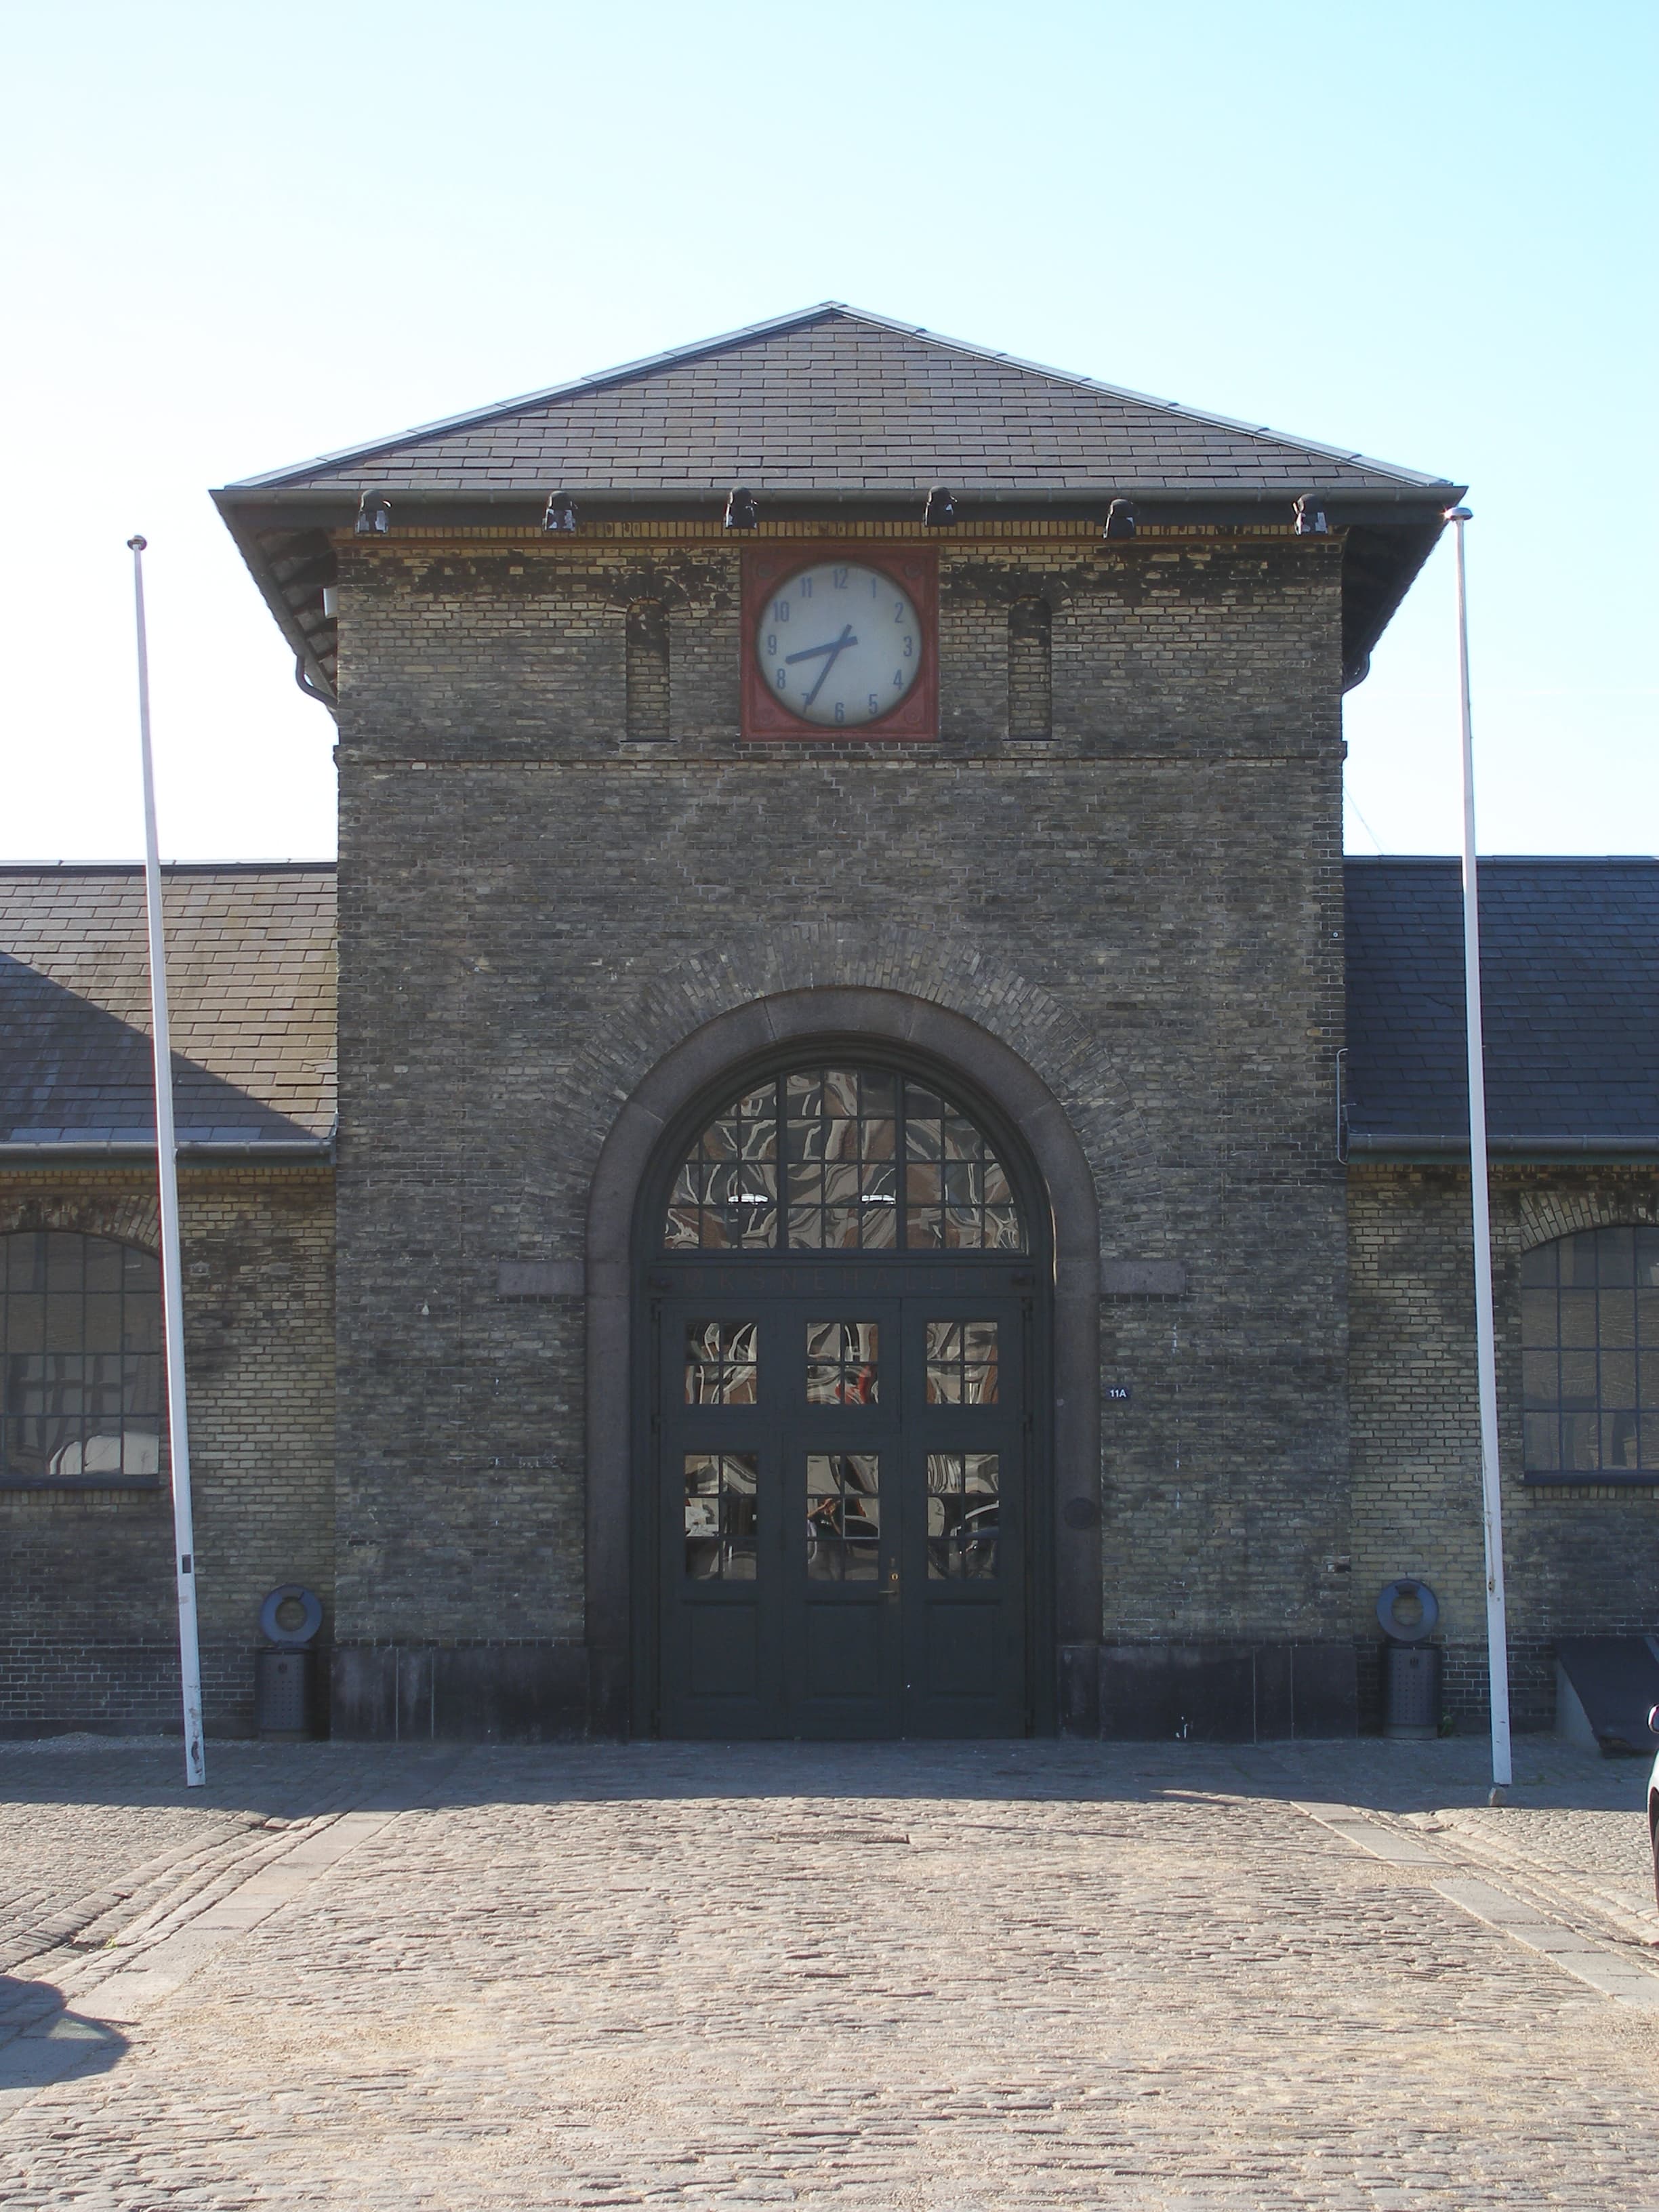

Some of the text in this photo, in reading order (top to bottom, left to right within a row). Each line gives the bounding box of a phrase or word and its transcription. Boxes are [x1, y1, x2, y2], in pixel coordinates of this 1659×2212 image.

[801, 577, 812, 598] 11
[833, 569, 848, 589] 12
[871, 578, 877, 598] 1
[773, 601, 790, 622] 10
[895, 602, 904, 623] 2
[767, 634, 777, 655] 9
[903, 636, 912, 657] 3
[777, 668, 786, 689] 8
[893, 670, 903, 690] 4
[802, 693, 811, 712] 7
[834, 702, 844, 722] 6
[868, 694, 878, 714] 5
[1110, 1389, 1126, 1397] 11A
